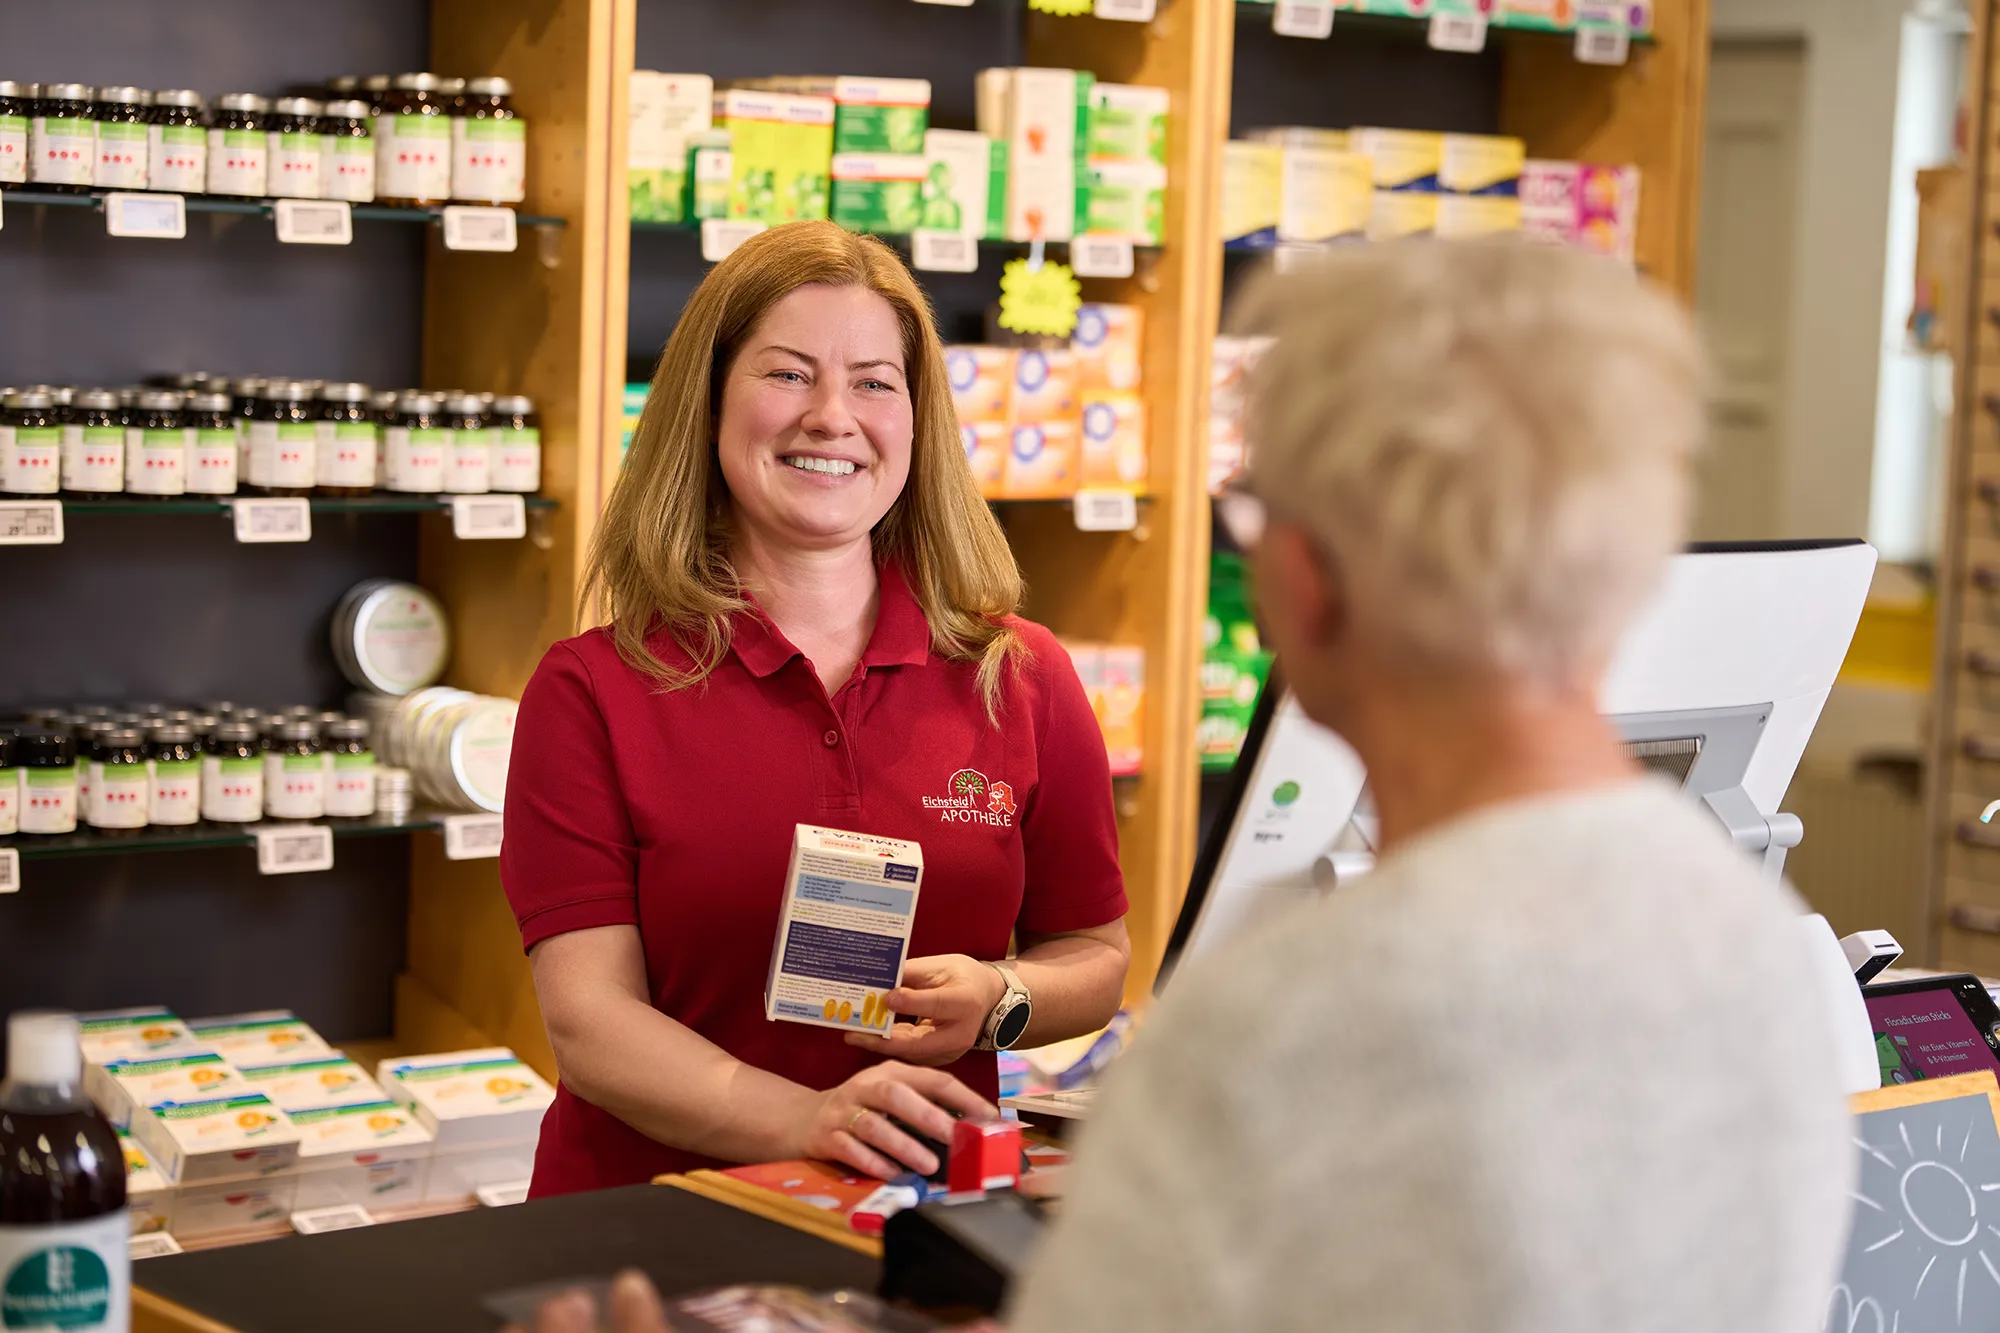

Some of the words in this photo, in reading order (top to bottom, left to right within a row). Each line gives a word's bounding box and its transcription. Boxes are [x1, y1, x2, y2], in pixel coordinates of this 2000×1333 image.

[922, 795, 969, 807] Eichsfeld
[941, 809, 1012, 827] APOTHEKE
[1885, 1015, 1913, 1026] Floradix
[1911, 1014, 1932, 1024] Eisen
[1930, 1011, 1951, 1020] Sticks
[1919, 1044, 1932, 1053] Mit
[1946, 1040, 1970, 1050] Vitamin
[1969, 1038, 1976, 1047] C
[1933, 1053, 1968, 1063] B-Vitaminen
